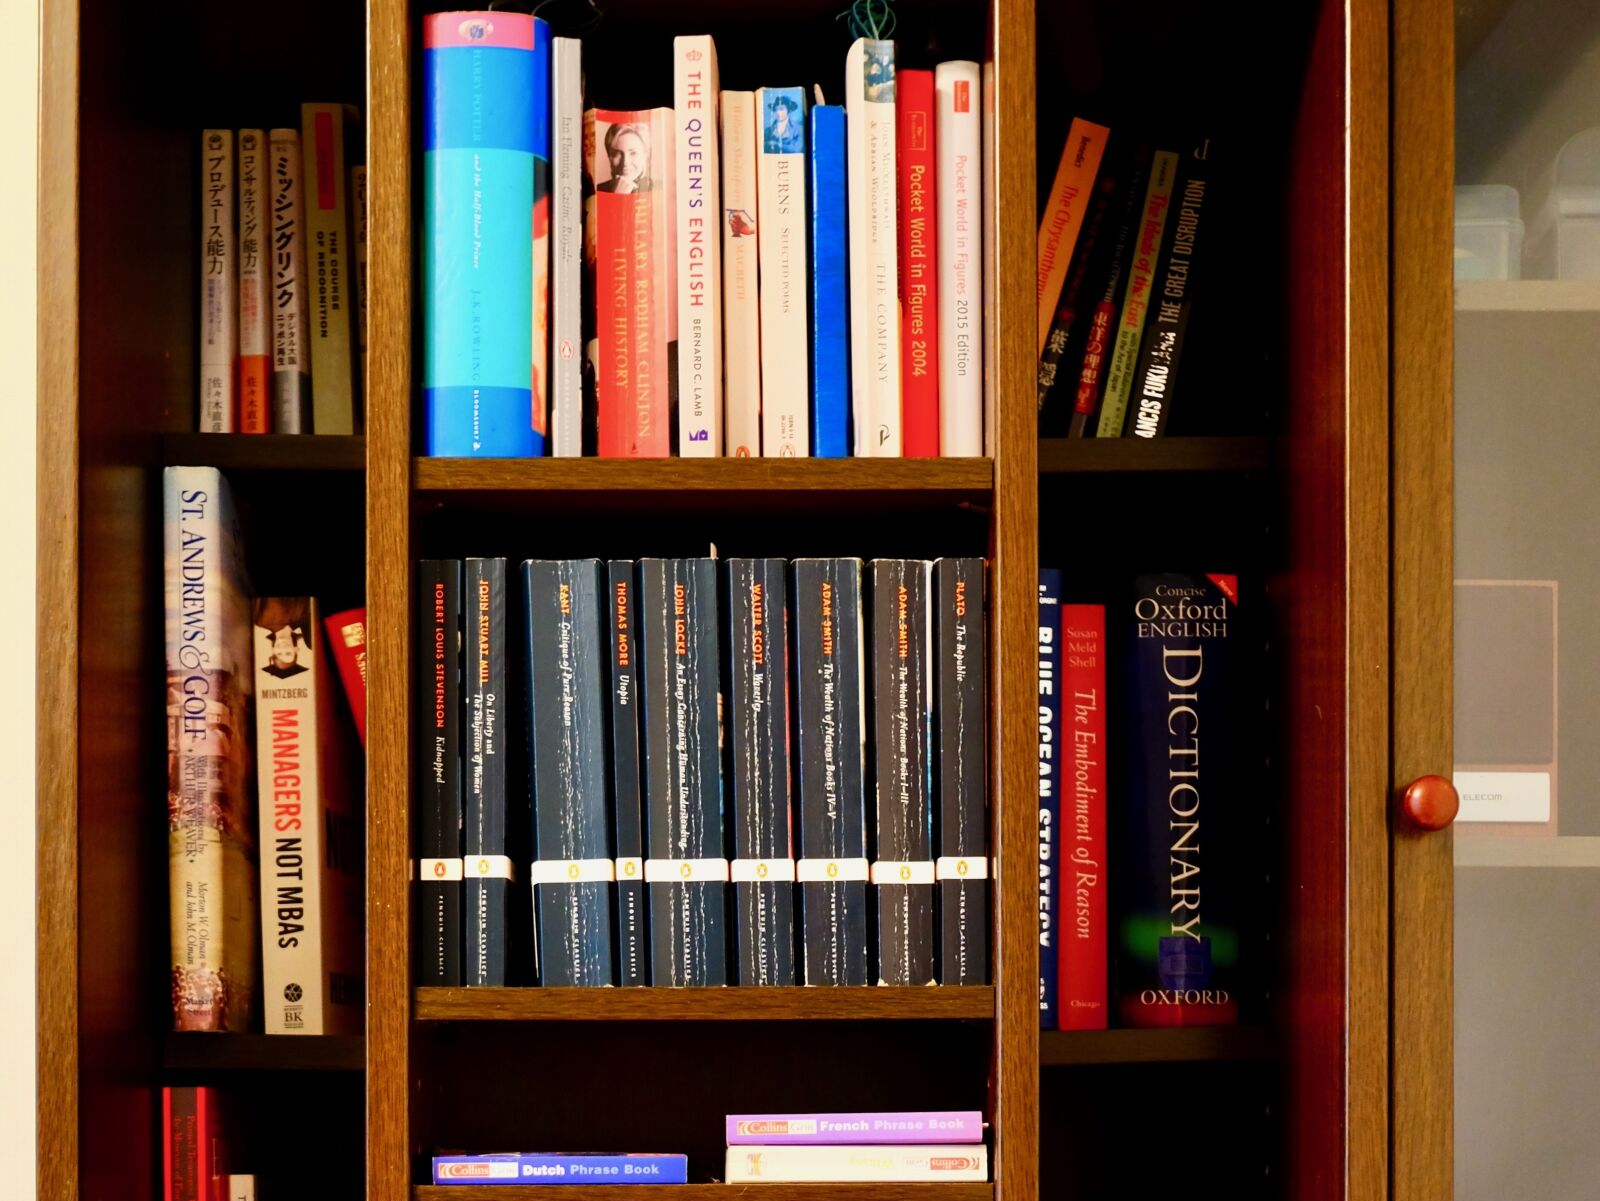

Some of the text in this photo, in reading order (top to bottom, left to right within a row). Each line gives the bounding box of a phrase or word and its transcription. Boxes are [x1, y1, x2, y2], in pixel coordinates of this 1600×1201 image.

[207, 155, 226, 275] プロデュース能力
[473, 154, 481, 268] and the Half-Blood Prince
[685, 72, 703, 307] THE QUEEN'S ENGLISH
[317, 231, 327, 338] OF RECOGNITION
[329, 231, 339, 310] THE COURSE
[954, 155, 969, 376] Pocket World in Figures 2015 Edition
[1158, 179, 1206, 323] THE GREAT DISRUPTION
[613, 249, 628, 389] LIVING HISTORY
[634, 198, 650, 437] HILLARY RODHAM CLINTON
[876, 264, 888, 383] THE COMPANY
[178, 490, 213, 741] ST. ANDREWS & GOLF
[617, 582, 629, 705] THOMAS MORE Utopia
[955, 582, 966, 682] PLATO The Republic
[1067, 627, 1097, 638] Susan
[1135, 597, 1228, 621] Oxford
[1138, 623, 1227, 638] ENGLISH
[1155, 584, 1206, 597] Concise
[261, 689, 308, 699] MINTZBERG
[434, 584, 446, 783] ROBERT LOUIS STEVENSON Kidnapped
[752, 584, 764, 712] WALTER SCOTT Waverley
[1067, 657, 1096, 668] Shell
[271, 709, 304, 949] MANAGERS NOT MBAs
[1071, 689, 1099, 939] The Embodiment of Reason
[1162, 645, 1203, 943] DICTIONARY
[1463, 793, 1502, 801] ELECOM
[182, 881, 196, 965] and John M. Olman
[1141, 989, 1229, 1005] OXFORD
[452, 1164, 659, 1176] Collins Dutch Phrase Book
[750, 1122, 787, 1133] Collins
[820, 1122, 869, 1131] French
[874, 1121, 923, 1130] Phrase
[929, 1119, 964, 1129] Book
